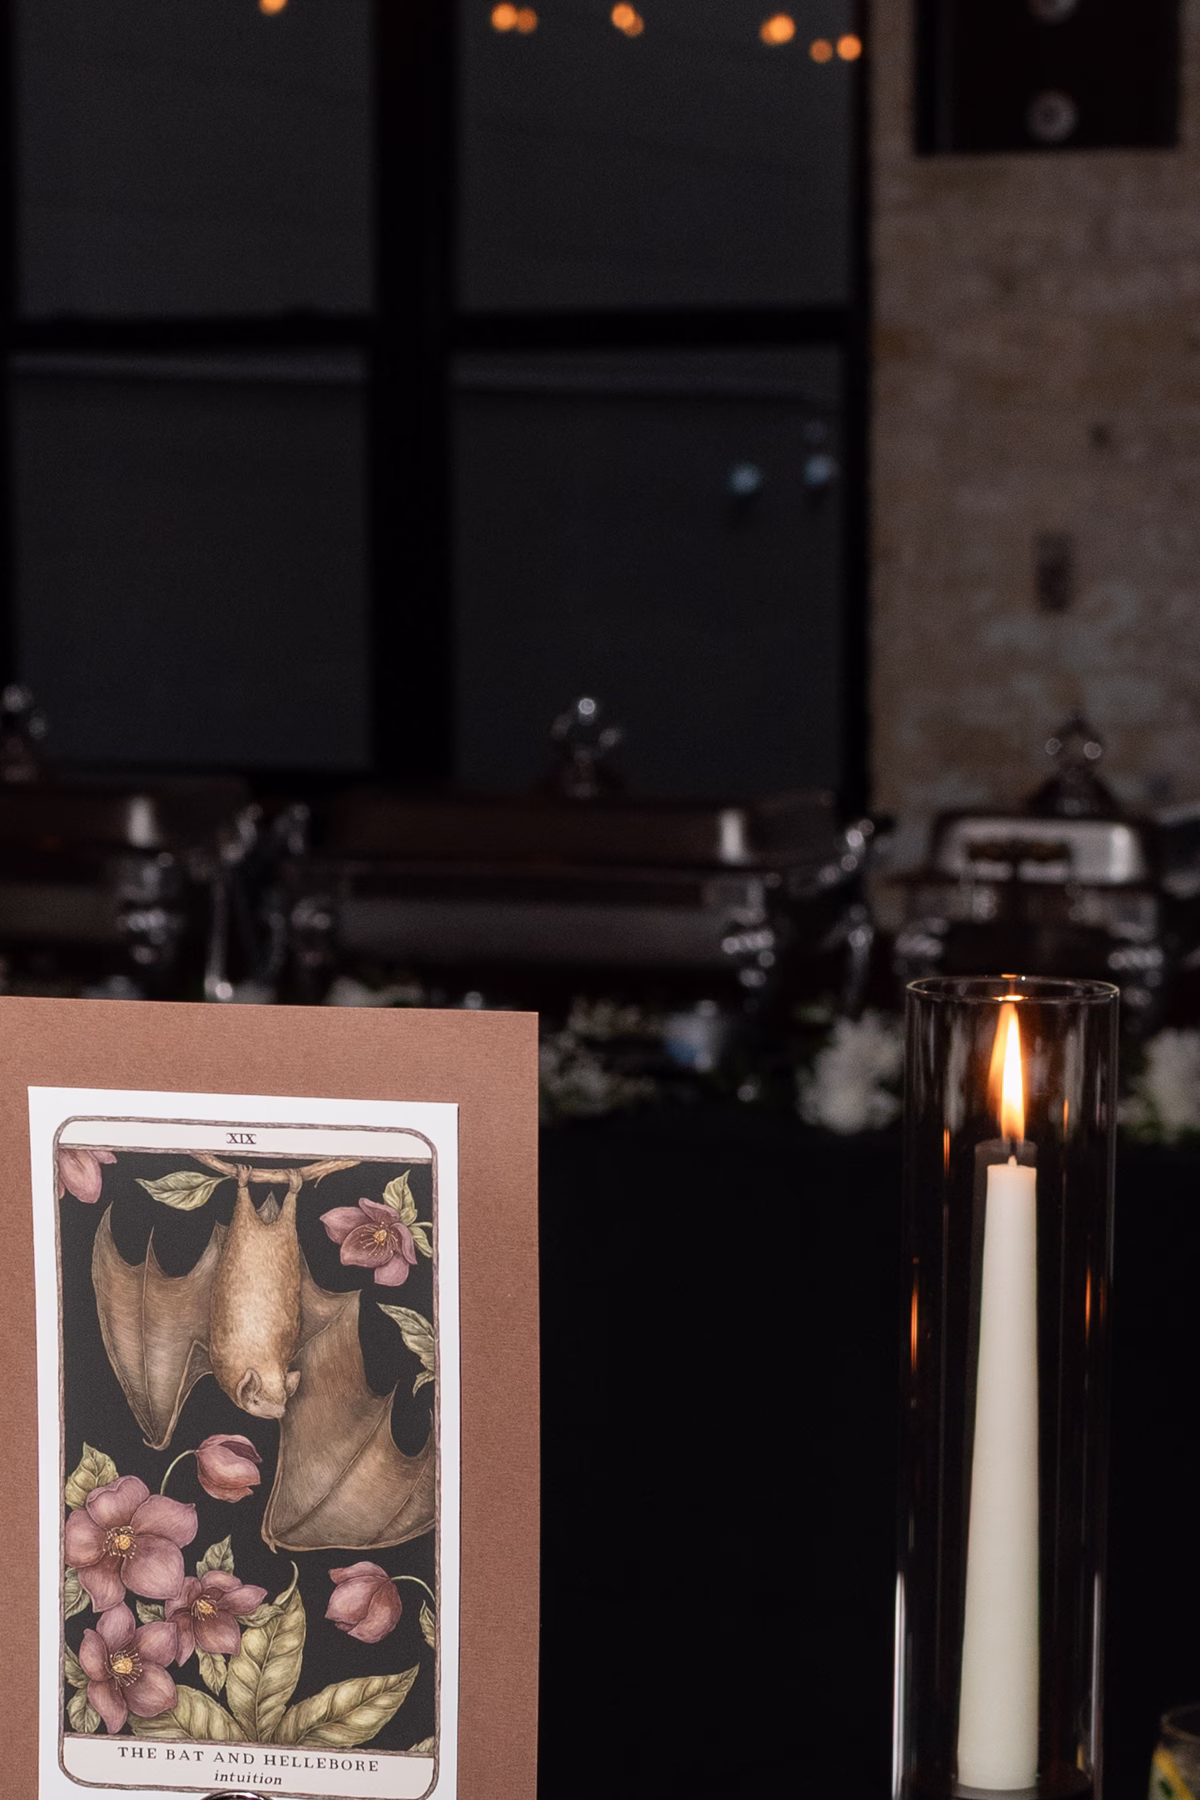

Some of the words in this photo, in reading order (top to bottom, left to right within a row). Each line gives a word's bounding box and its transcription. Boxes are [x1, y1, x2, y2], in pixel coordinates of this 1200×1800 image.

[225, 1132, 257, 1145] XIX
[117, 1746, 157, 1760] THE
[166, 1749, 204, 1762] BAT
[213, 1752, 255, 1765] AND
[263, 1755, 380, 1772] HELLEBORE
[214, 1769, 283, 1786] intuition
